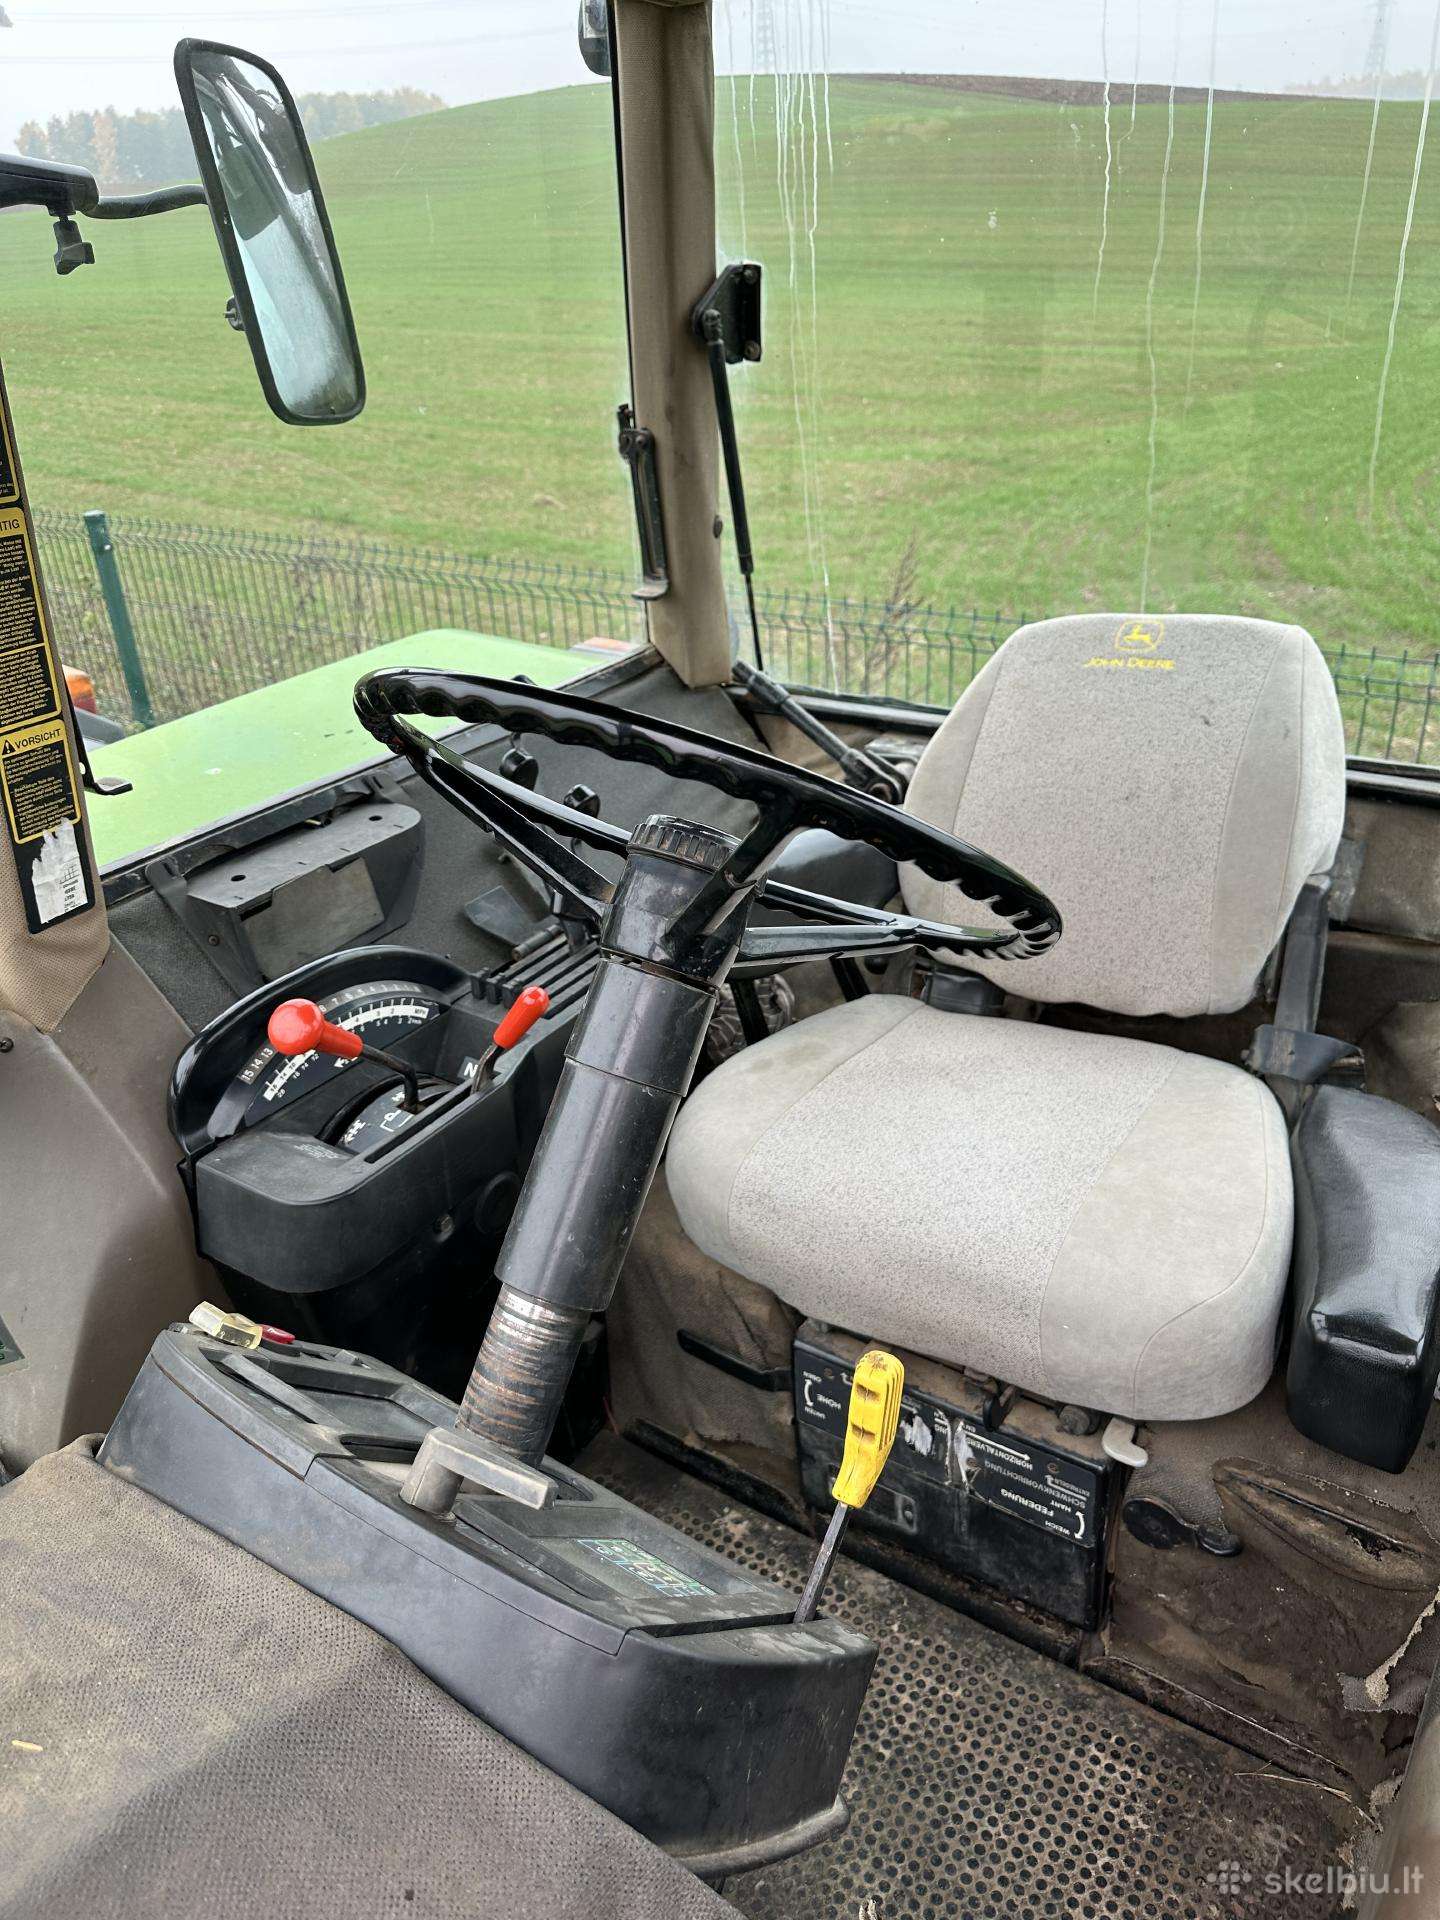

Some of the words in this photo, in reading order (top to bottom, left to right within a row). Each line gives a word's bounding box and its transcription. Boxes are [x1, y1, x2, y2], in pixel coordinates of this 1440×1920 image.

[1084, 656, 1123, 668] JOHN
[1127, 656, 1175, 670] DEERE
[15, 728, 61, 749] VORSICHT
[241, 1070, 255, 1081] 15
[251, 1058, 264, 1069] 14
[261, 1048, 274, 1058] 13
[464, 1062, 479, 1078] N
[984, 1461, 1086, 1509] SCHWENKVORRICHTUNG
[1001, 1488, 1055, 1517] FEDERUNG
[1045, 1521, 1071, 1536] WEICH
